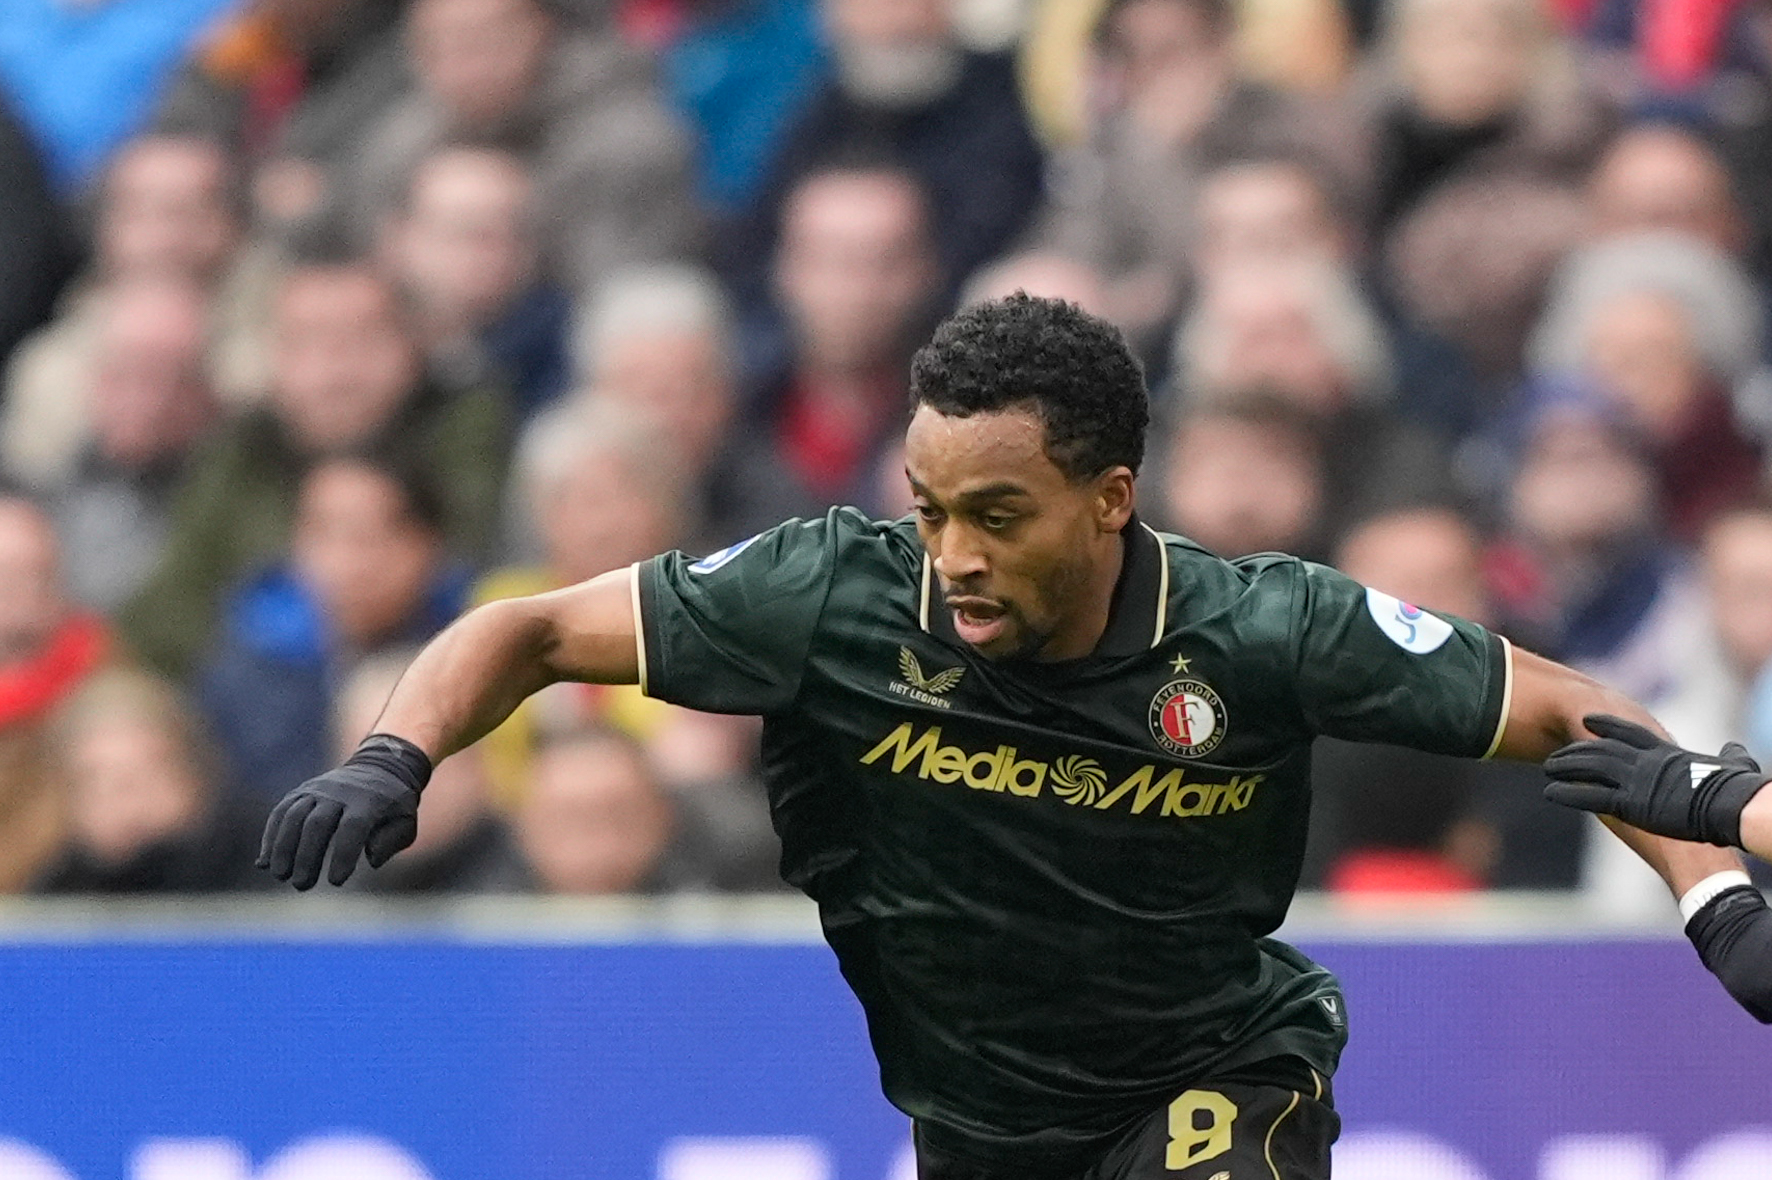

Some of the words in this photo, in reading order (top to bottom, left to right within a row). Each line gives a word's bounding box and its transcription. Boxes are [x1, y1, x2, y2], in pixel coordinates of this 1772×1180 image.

[888, 681, 910, 696] HET
[1153, 683, 1218, 712] FEYENOORD
[1158, 727, 1224, 756] ROTTERDAM
[858, 721, 1048, 798] Media
[1092, 764, 1267, 817] Markt
[1165, 1089, 1238, 1171] 8
